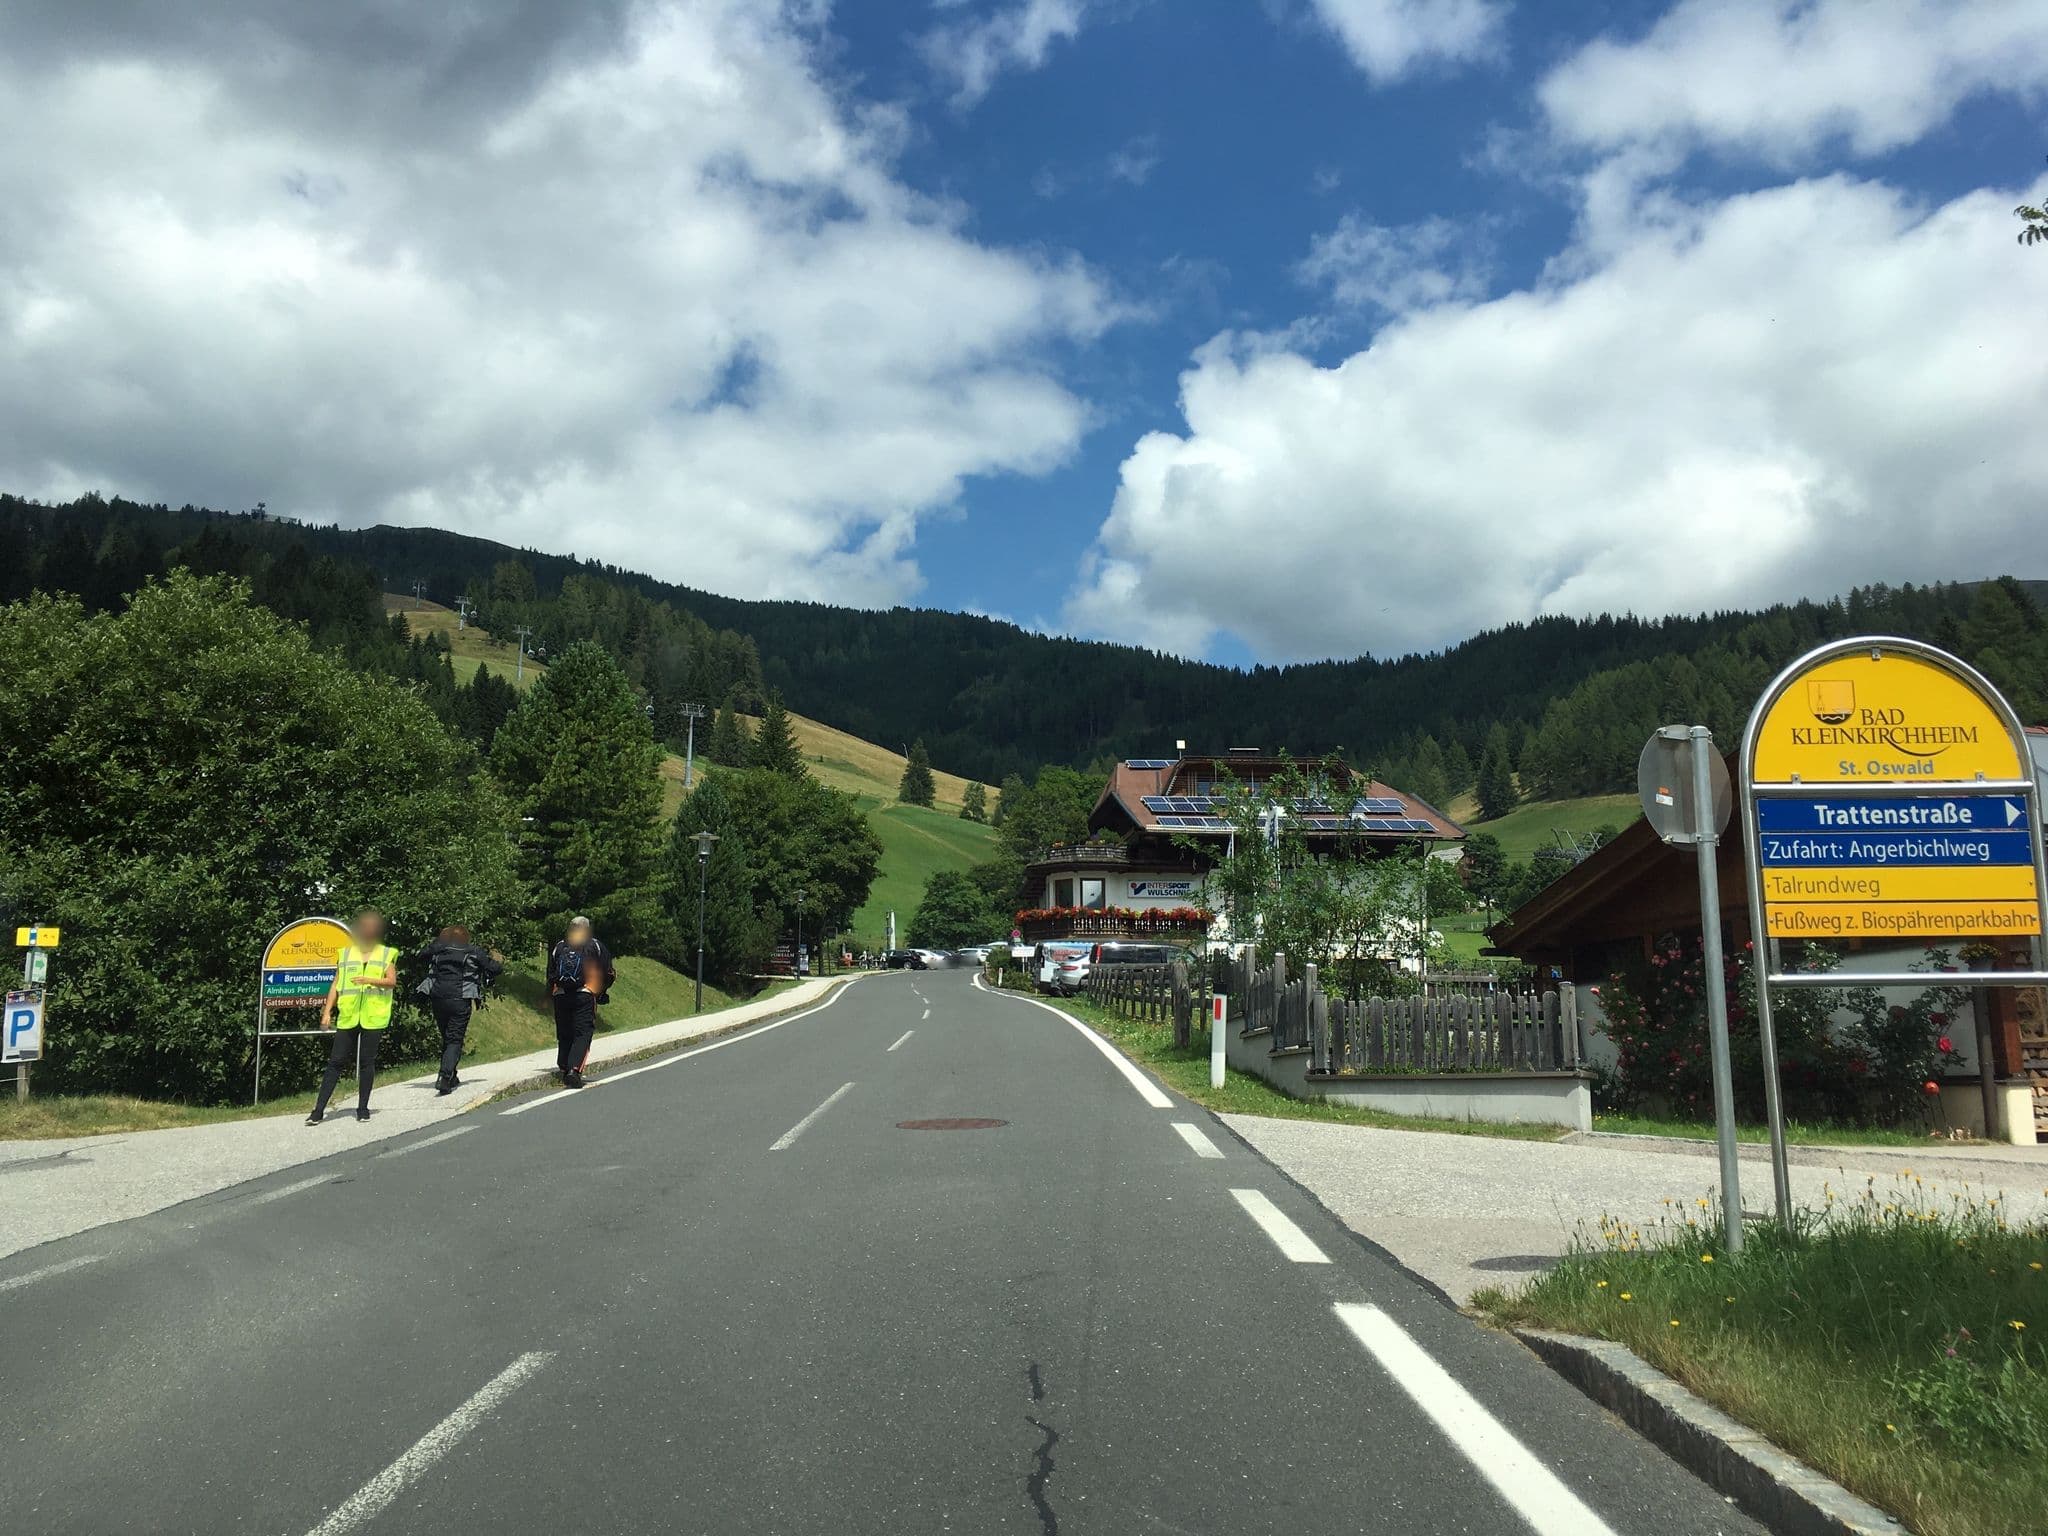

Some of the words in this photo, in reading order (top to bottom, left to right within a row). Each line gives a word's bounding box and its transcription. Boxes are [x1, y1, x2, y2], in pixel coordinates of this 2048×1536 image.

[1860, 708, 1905, 726] BAD
[1791, 726, 1979, 750] KLEINKIRCHHEIM
[1838, 760, 1862, 776] St.
[1866, 760, 1934, 776] Oswald
[1813, 802, 1973, 826] Trattenstraße
[1768, 839, 1844, 860] Zufahrt:
[1849, 838, 1990, 863] Angerbichlweg
[1771, 875, 1880, 898] Talrundweg
[1774, 910, 1842, 934] Fußweg
[1845, 915, 1859, 930] z.
[1861, 909, 2034, 934] Biospährenparkbahn
[285, 973, 334, 982] Brunnachwe
[266, 986, 295, 995] Almhaus
[297, 986, 321, 994] Perfler
[10, 1010, 35, 1047] P
